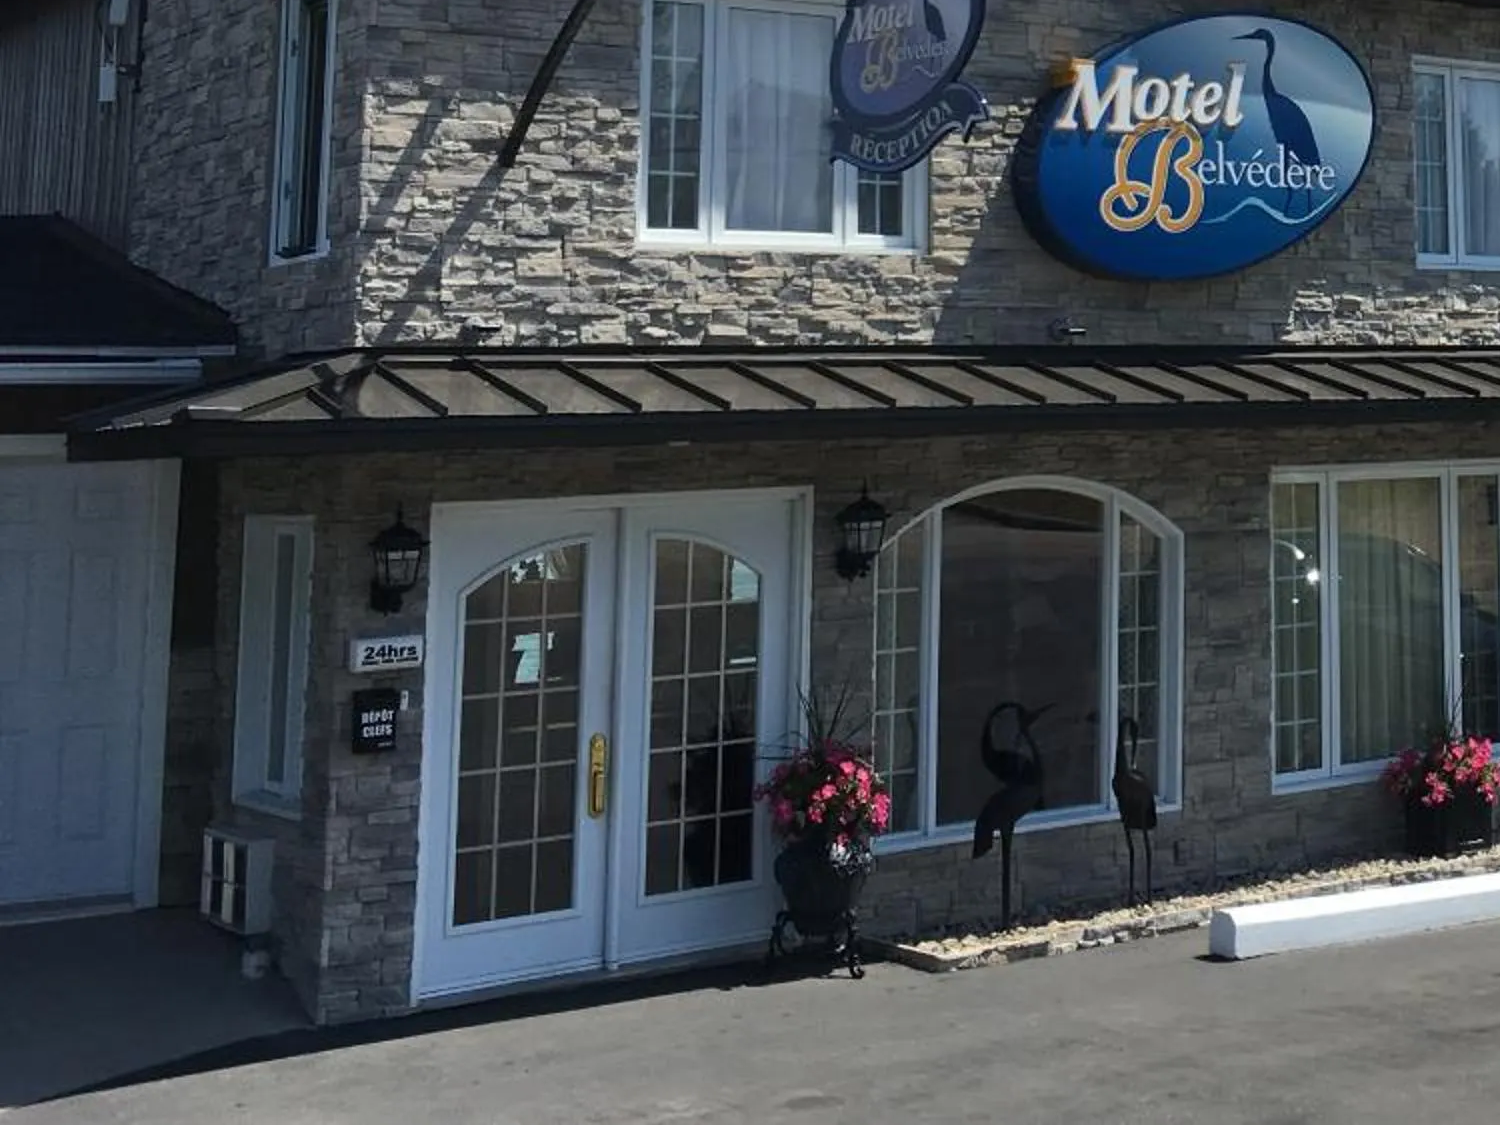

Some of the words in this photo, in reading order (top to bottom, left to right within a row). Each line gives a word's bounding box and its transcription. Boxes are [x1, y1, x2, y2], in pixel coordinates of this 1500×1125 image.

[1055, 59, 1247, 132] Motel
[1100, 119, 1336, 232] Belvédère
[363, 644, 417, 660] 24hrs
